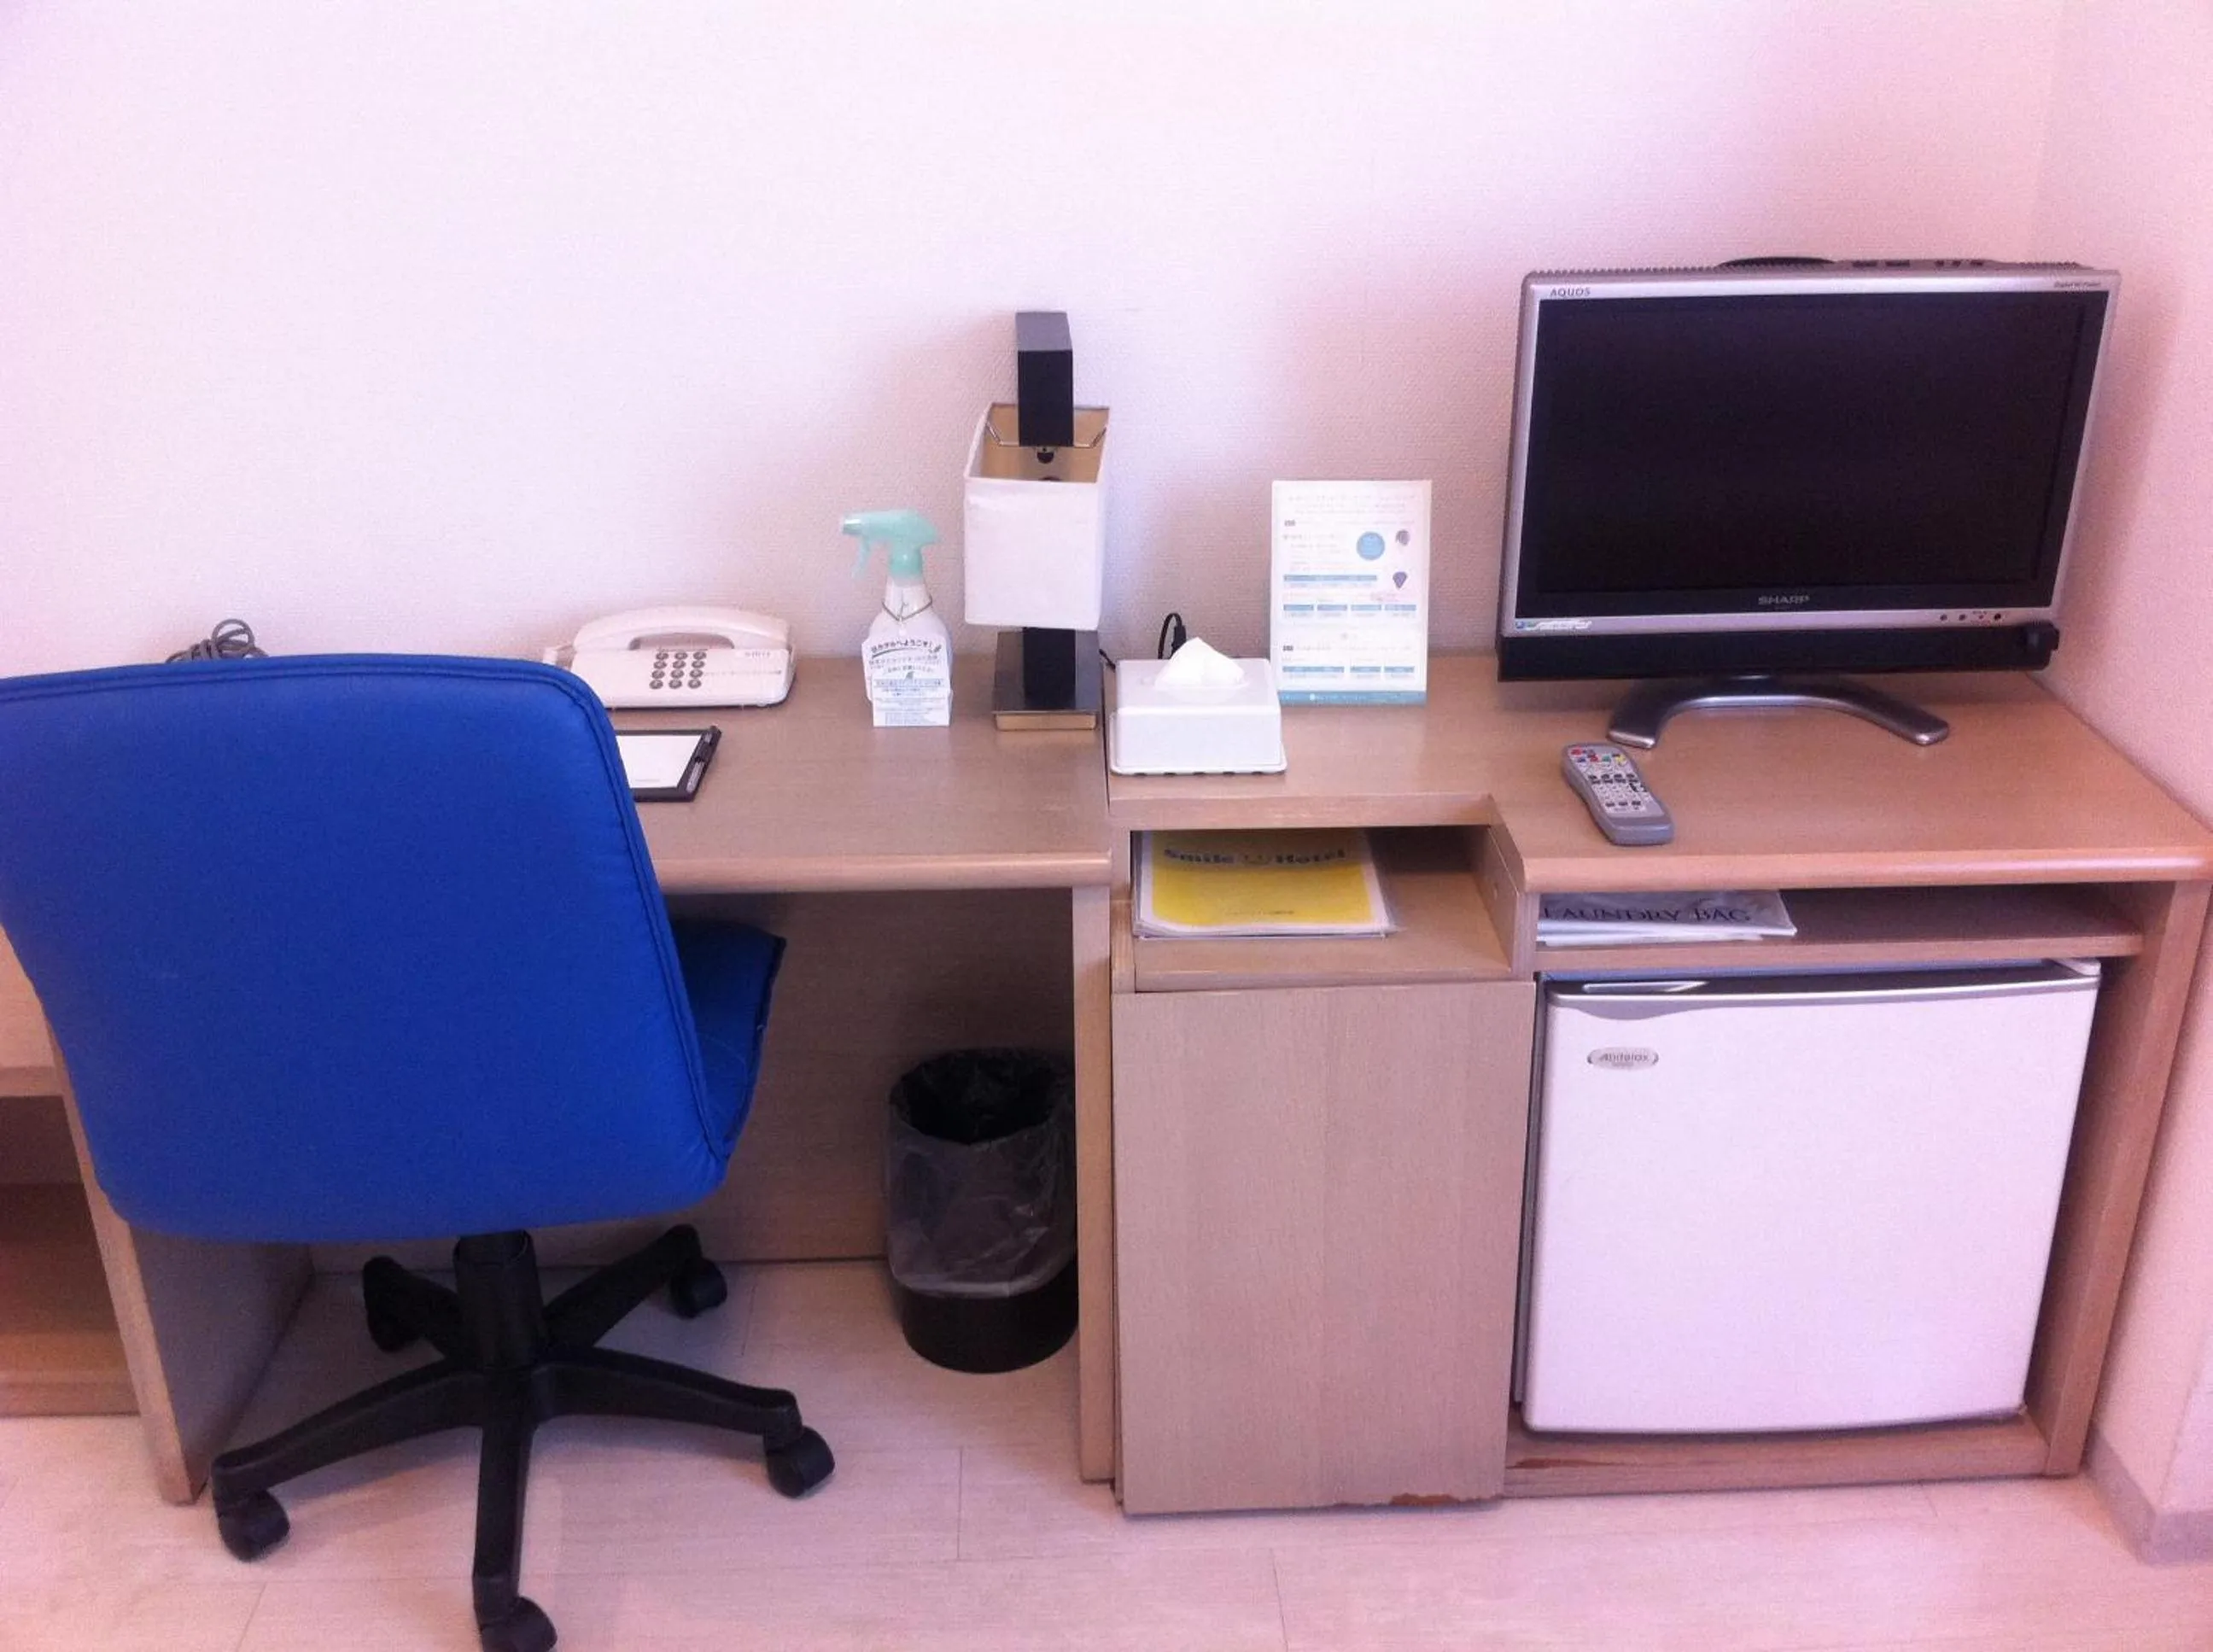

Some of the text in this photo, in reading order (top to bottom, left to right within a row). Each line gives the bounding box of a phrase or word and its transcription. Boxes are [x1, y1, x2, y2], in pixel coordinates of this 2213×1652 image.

[1550, 286, 1591, 297] AQUOS
[1758, 595, 1810, 605] SHARP
[1164, 849, 1345, 864] Smile Hotel
[1544, 907, 1750, 922] LAUNDRY BAG
